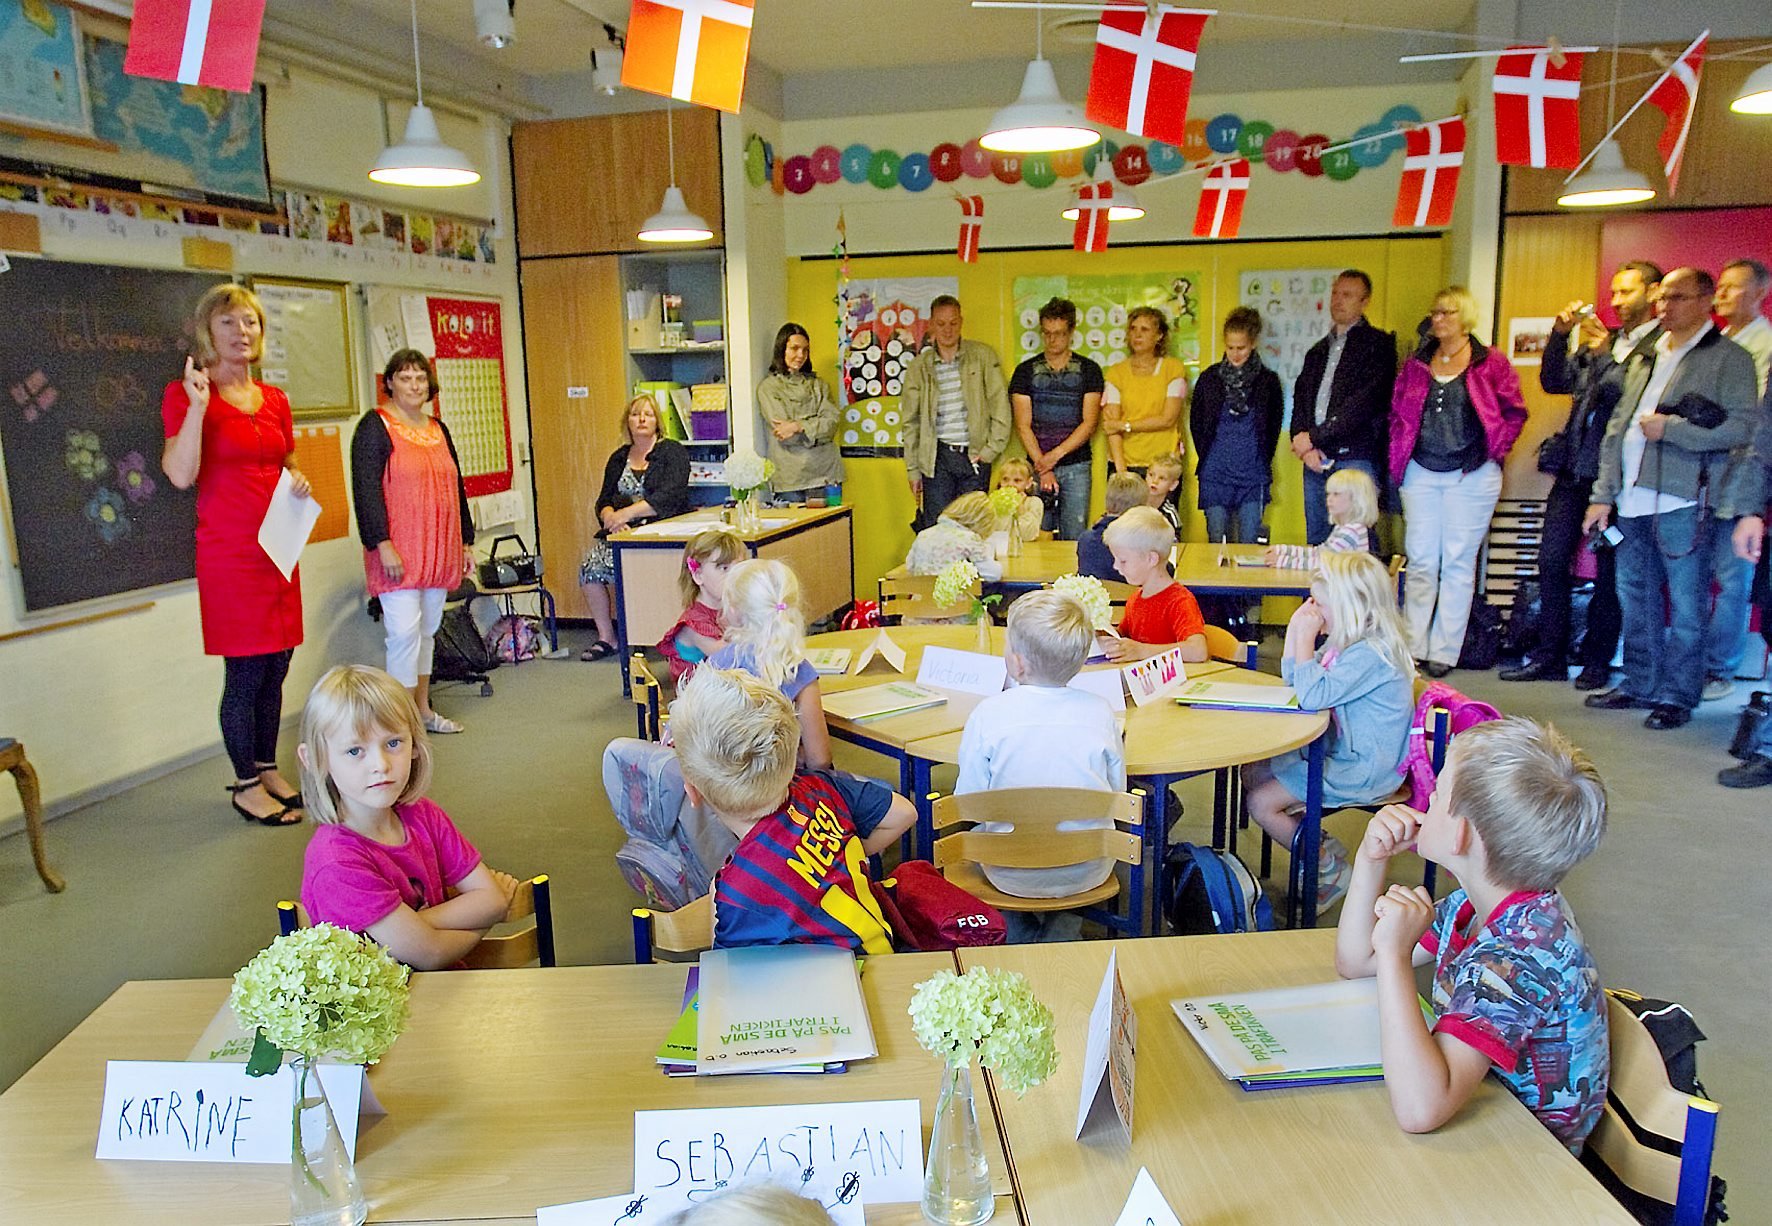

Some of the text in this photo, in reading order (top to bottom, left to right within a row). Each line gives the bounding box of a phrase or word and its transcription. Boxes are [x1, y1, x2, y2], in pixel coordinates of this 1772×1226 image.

[795, 169, 804, 181] 3
[821, 159, 830, 172] 4
[851, 158, 859, 171] 5
[882, 162, 890, 175] 6
[912, 165, 920, 178] 7
[940, 152, 949, 165] 8
[975, 151, 983, 163] 9
[1002, 158, 1018, 171] 10
[1034, 162, 1046, 175] 11
[1127, 157, 1141, 169] 14
[1162, 148, 1174, 160] 15
[1222, 129, 1236, 142] 17
[1248, 134, 1263, 147] 18
[1276, 148, 1290, 160] 19
[1335, 154, 1348, 167] 21
[787, 801, 845, 889] MESSI
[957, 914, 989, 928] FCB
[730, 1016, 840, 1033] I TRAFIKKEN
[792, 1027, 816, 1038] PÅ
[819, 1025, 852, 1036] PAS
[1231, 1004, 1280, 1048] TRAFIKKEN
[764, 1028, 788, 1040] DE
[1245, 1045, 1272, 1061] PAS
[119, 1089, 253, 1157] KATRINE
[655, 1125, 904, 1187] SEBASTIAN
